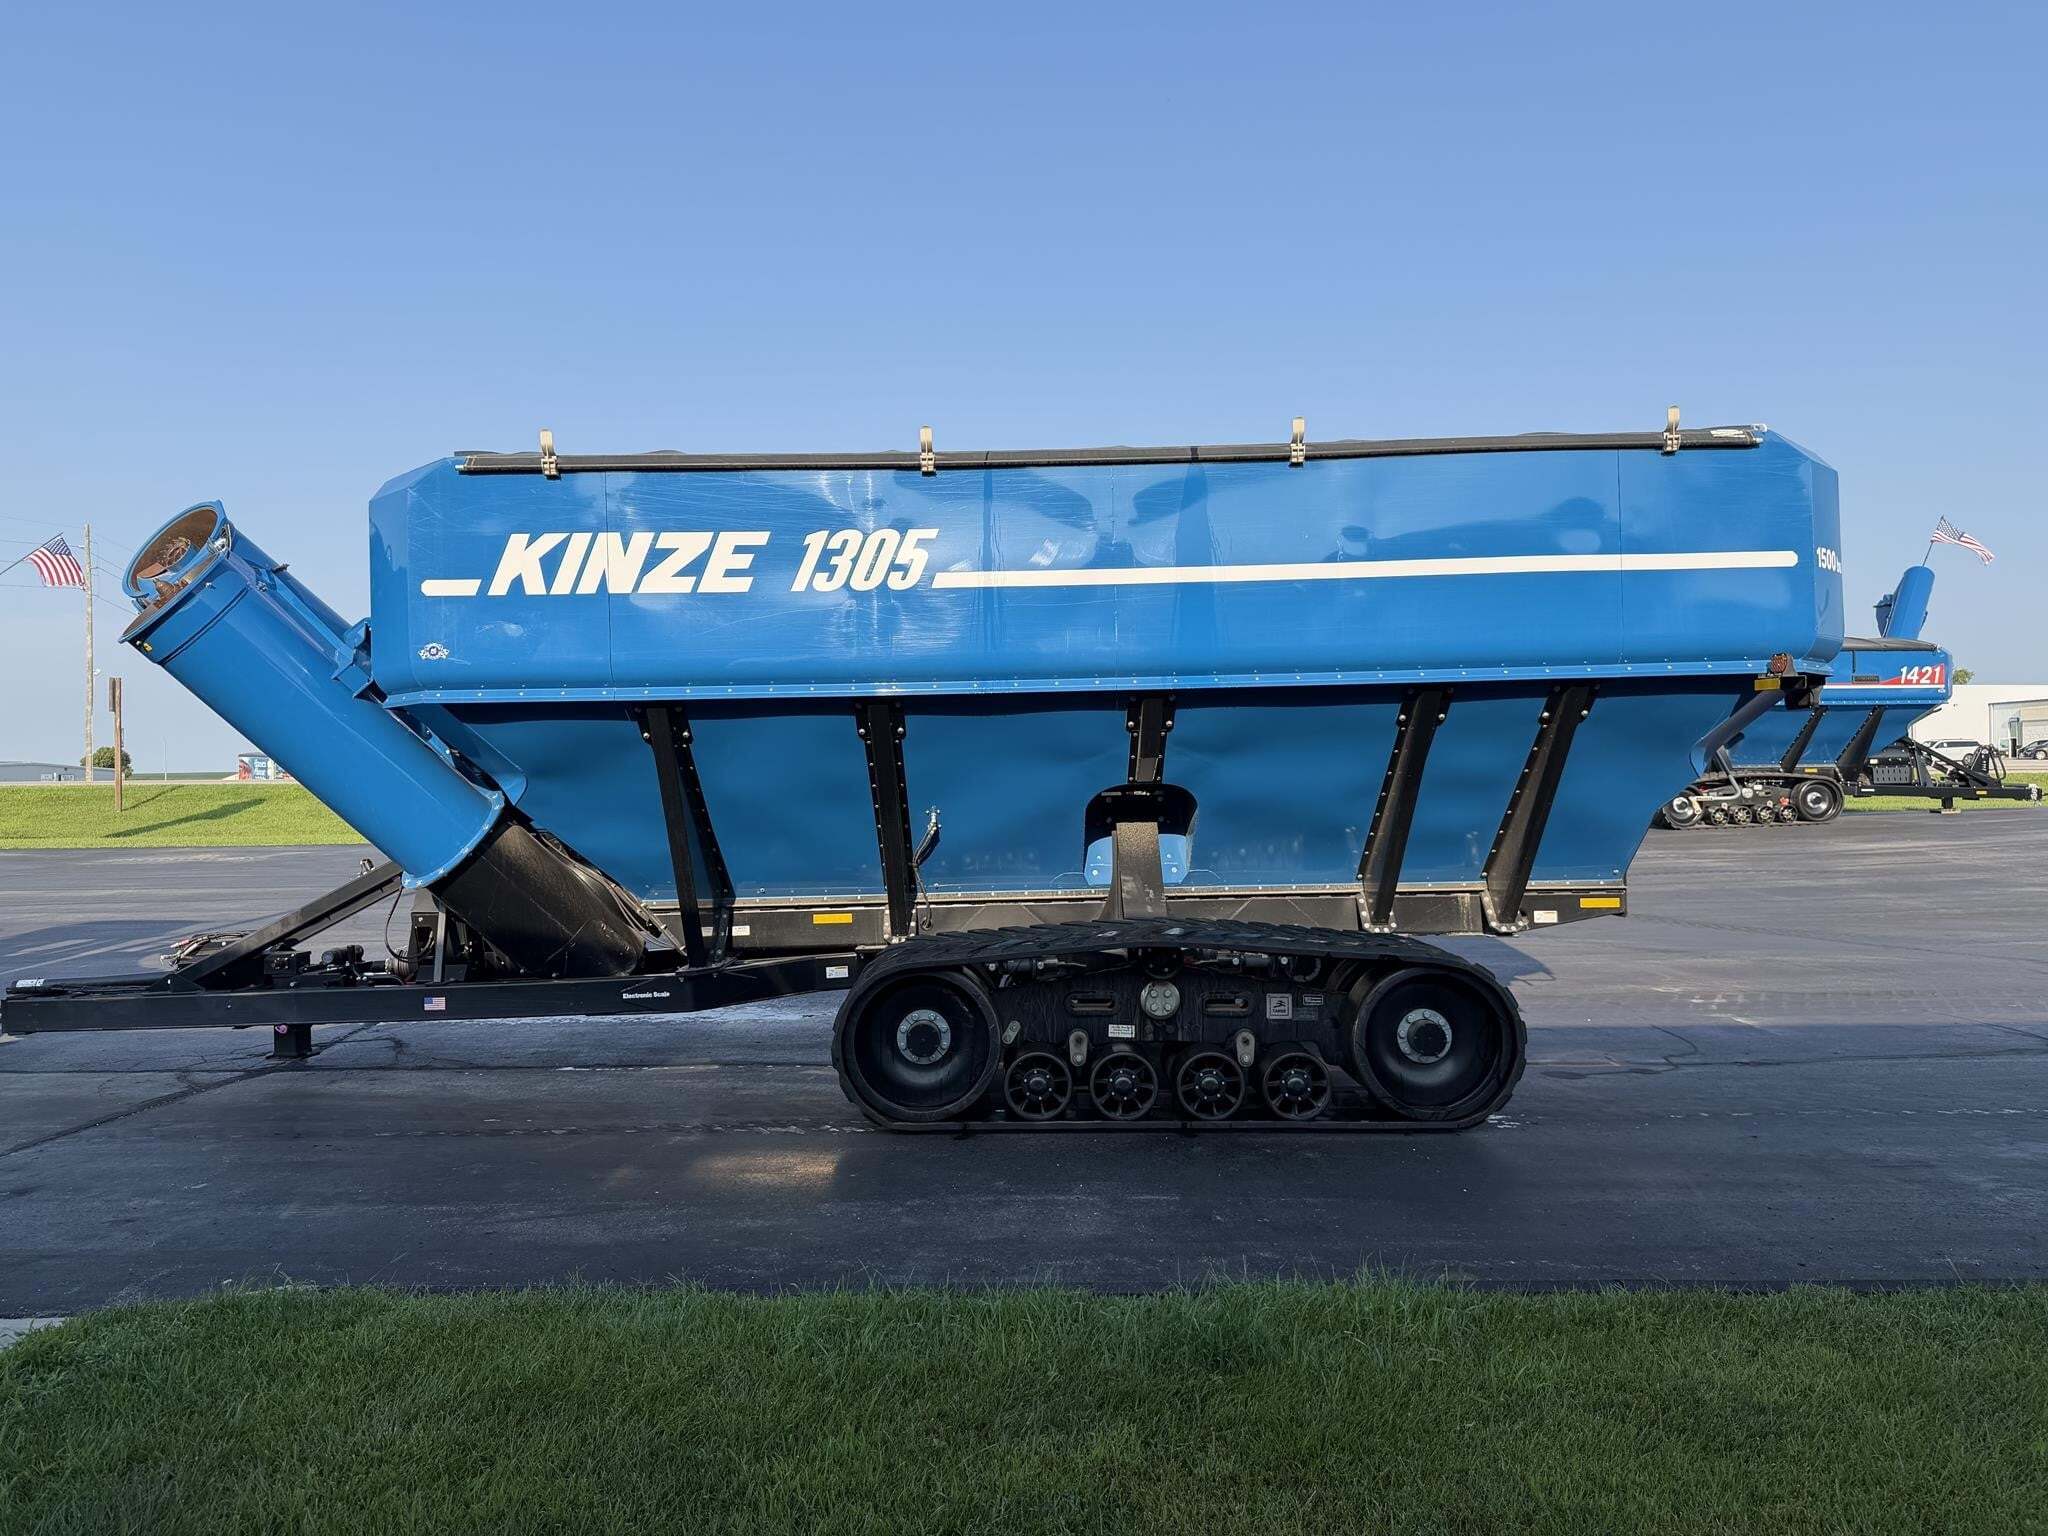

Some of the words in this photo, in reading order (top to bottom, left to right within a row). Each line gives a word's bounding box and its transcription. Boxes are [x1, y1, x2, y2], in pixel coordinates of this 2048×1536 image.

[487, 530, 771, 596] KINZE
[791, 527, 940, 593] 1305
[1816, 547, 1836, 572] 1500
[1900, 665, 1941, 684] 1421
